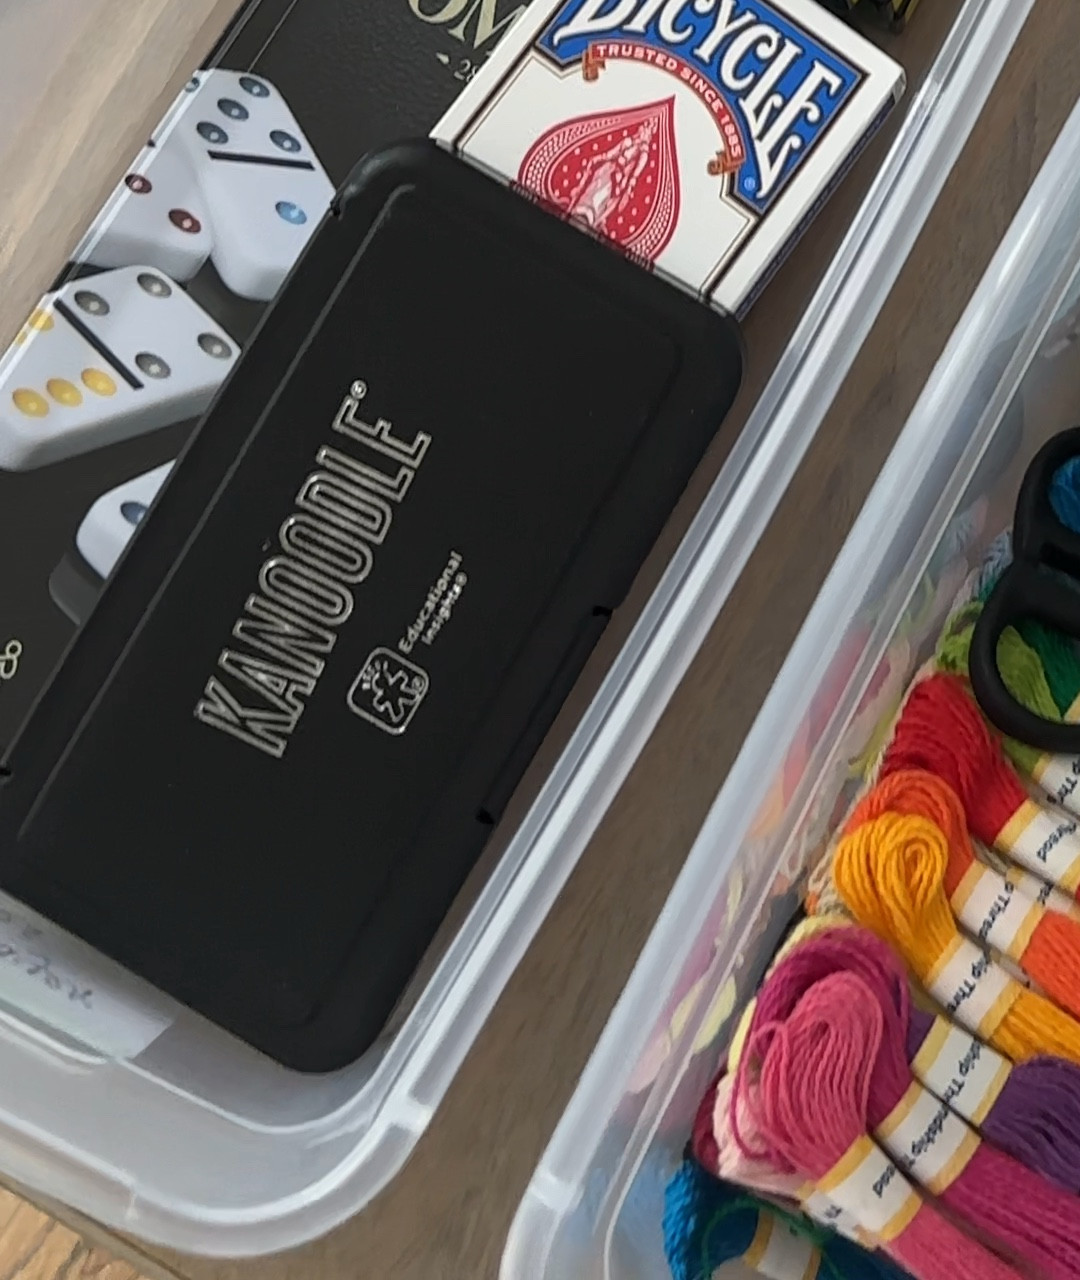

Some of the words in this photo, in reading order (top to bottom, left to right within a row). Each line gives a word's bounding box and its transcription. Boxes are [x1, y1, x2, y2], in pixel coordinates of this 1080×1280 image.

[597, 45, 678, 71] TRUSTED
[680, 65, 724, 111] SINCE
[721, 114, 742, 158] 1885
[397, 549, 464, 654] Educational
